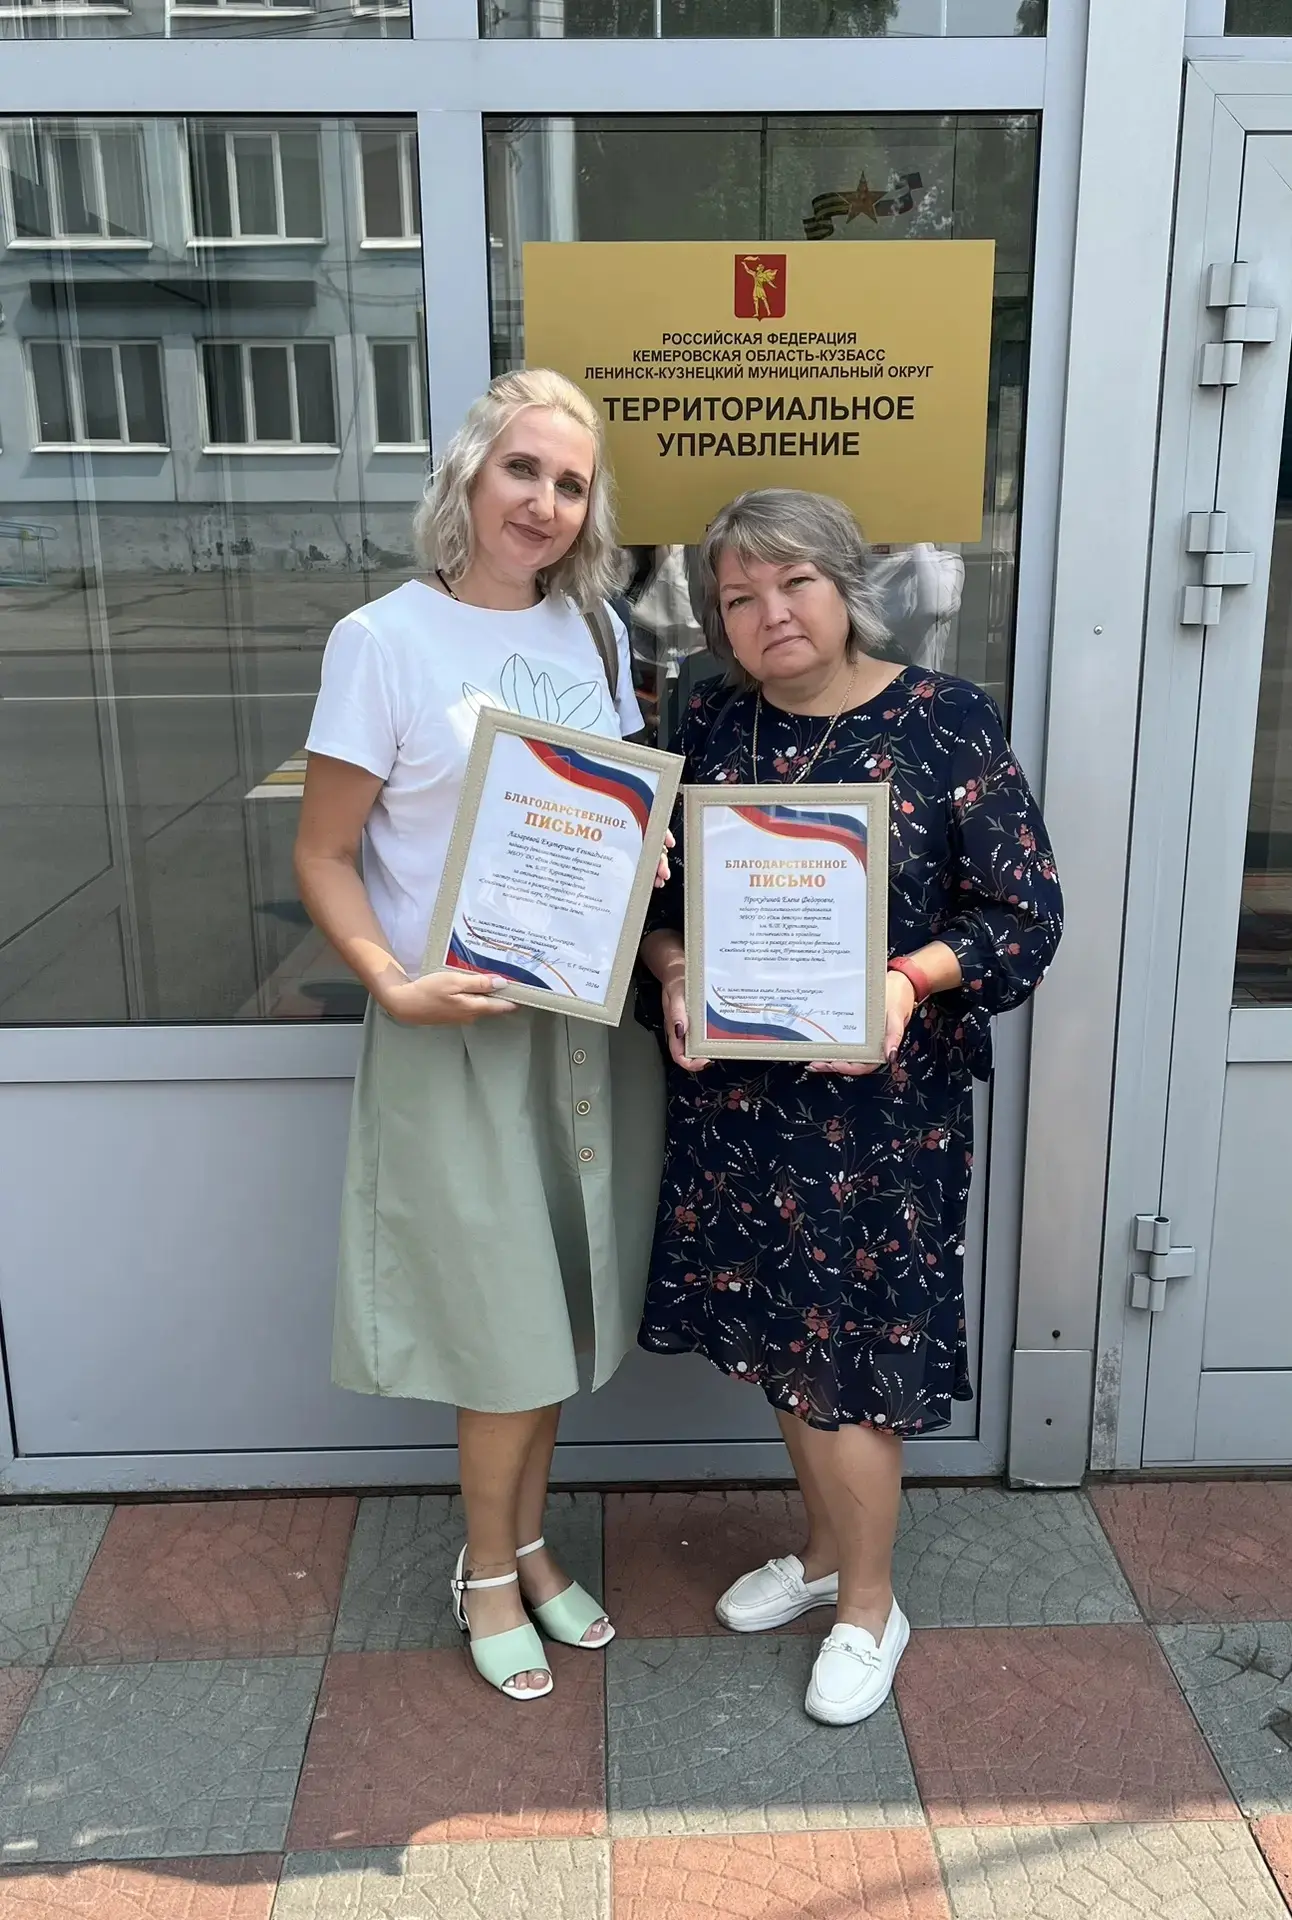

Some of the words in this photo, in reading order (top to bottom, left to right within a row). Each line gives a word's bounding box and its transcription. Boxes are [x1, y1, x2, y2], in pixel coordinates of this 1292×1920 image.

[662, 331, 762, 345] РОССИЙСКАЯ
[767, 332, 857, 346] ФЕДЕРАЦИЯ
[633, 350, 741, 362] КЕМЕРОВСКАЯ
[748, 349, 886, 362] ОБЛАСТЬ-КУЗБАСС
[585, 364, 743, 380] ЛЕНИНСК-КУЗНЕЦКИЙ
[748, 364, 883, 380] МУНИЦИПАЛЬНЫЙ
[888, 366, 934, 378] ОКРУГ
[602, 396, 915, 421] ТЕРРИТОРИАЛЬНОЕ
[657, 432, 860, 456] УПРАВЛЕНИЕ
[503, 790, 627, 830] БЛАГОДАРСТВЕННОЕ
[523, 810, 603, 842] ПИСЬМО
[725, 860, 847, 869] БЛАГОДАРСТВЕННОЕ
[749, 874, 826, 887] ПИСЬМО
